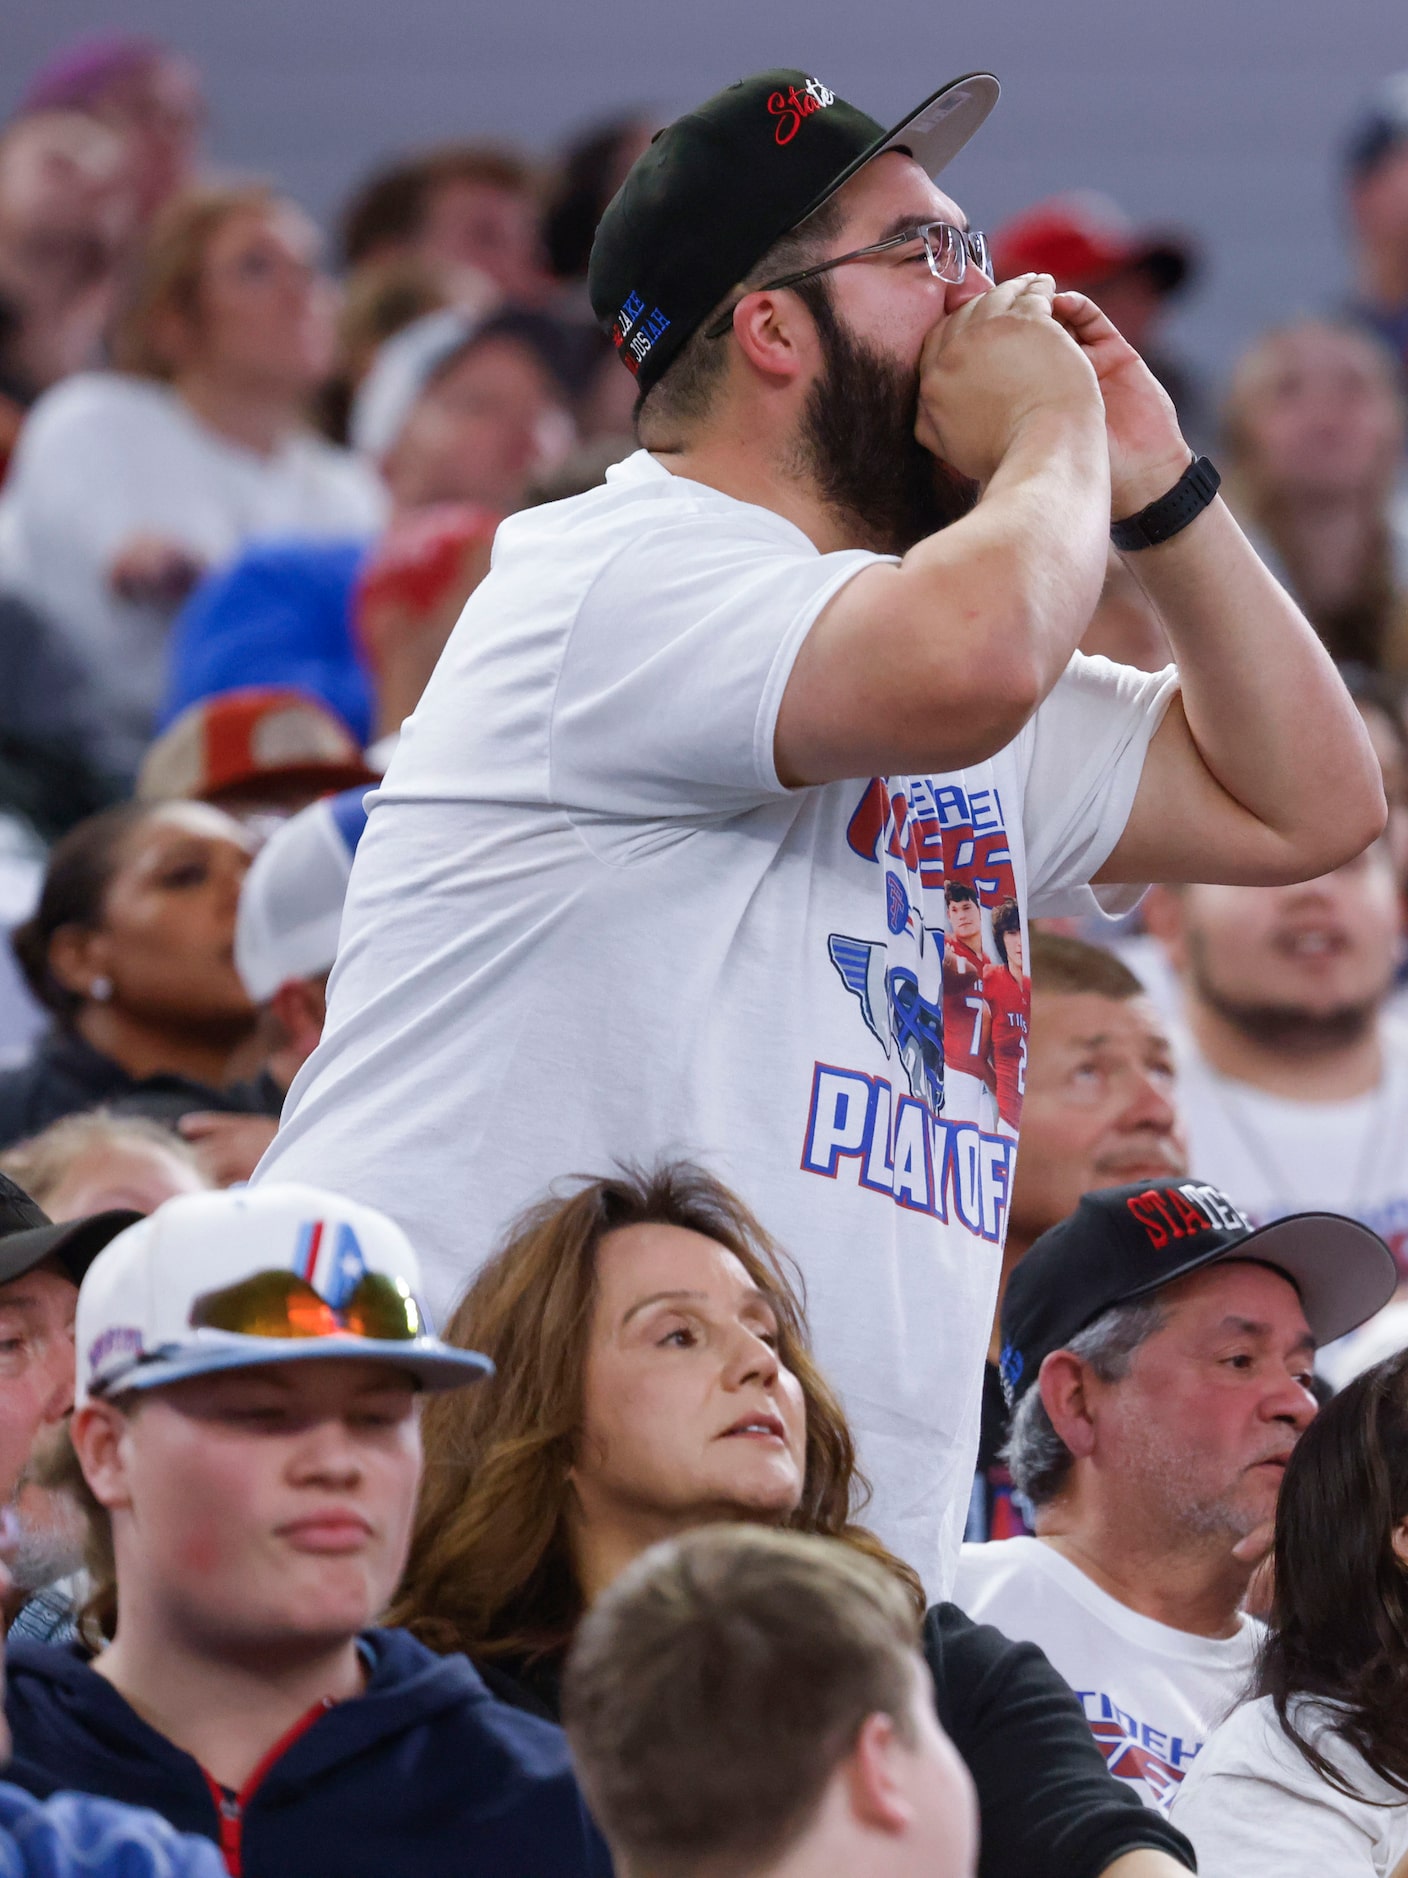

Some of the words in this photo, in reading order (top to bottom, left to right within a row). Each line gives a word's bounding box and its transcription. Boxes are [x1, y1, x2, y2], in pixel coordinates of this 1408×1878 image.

[618, 290, 646, 337] JAKE
[629, 306, 672, 362] JOSIAH
[965, 997, 984, 1056] 7
[800, 1060, 1018, 1244] PLAYOF
